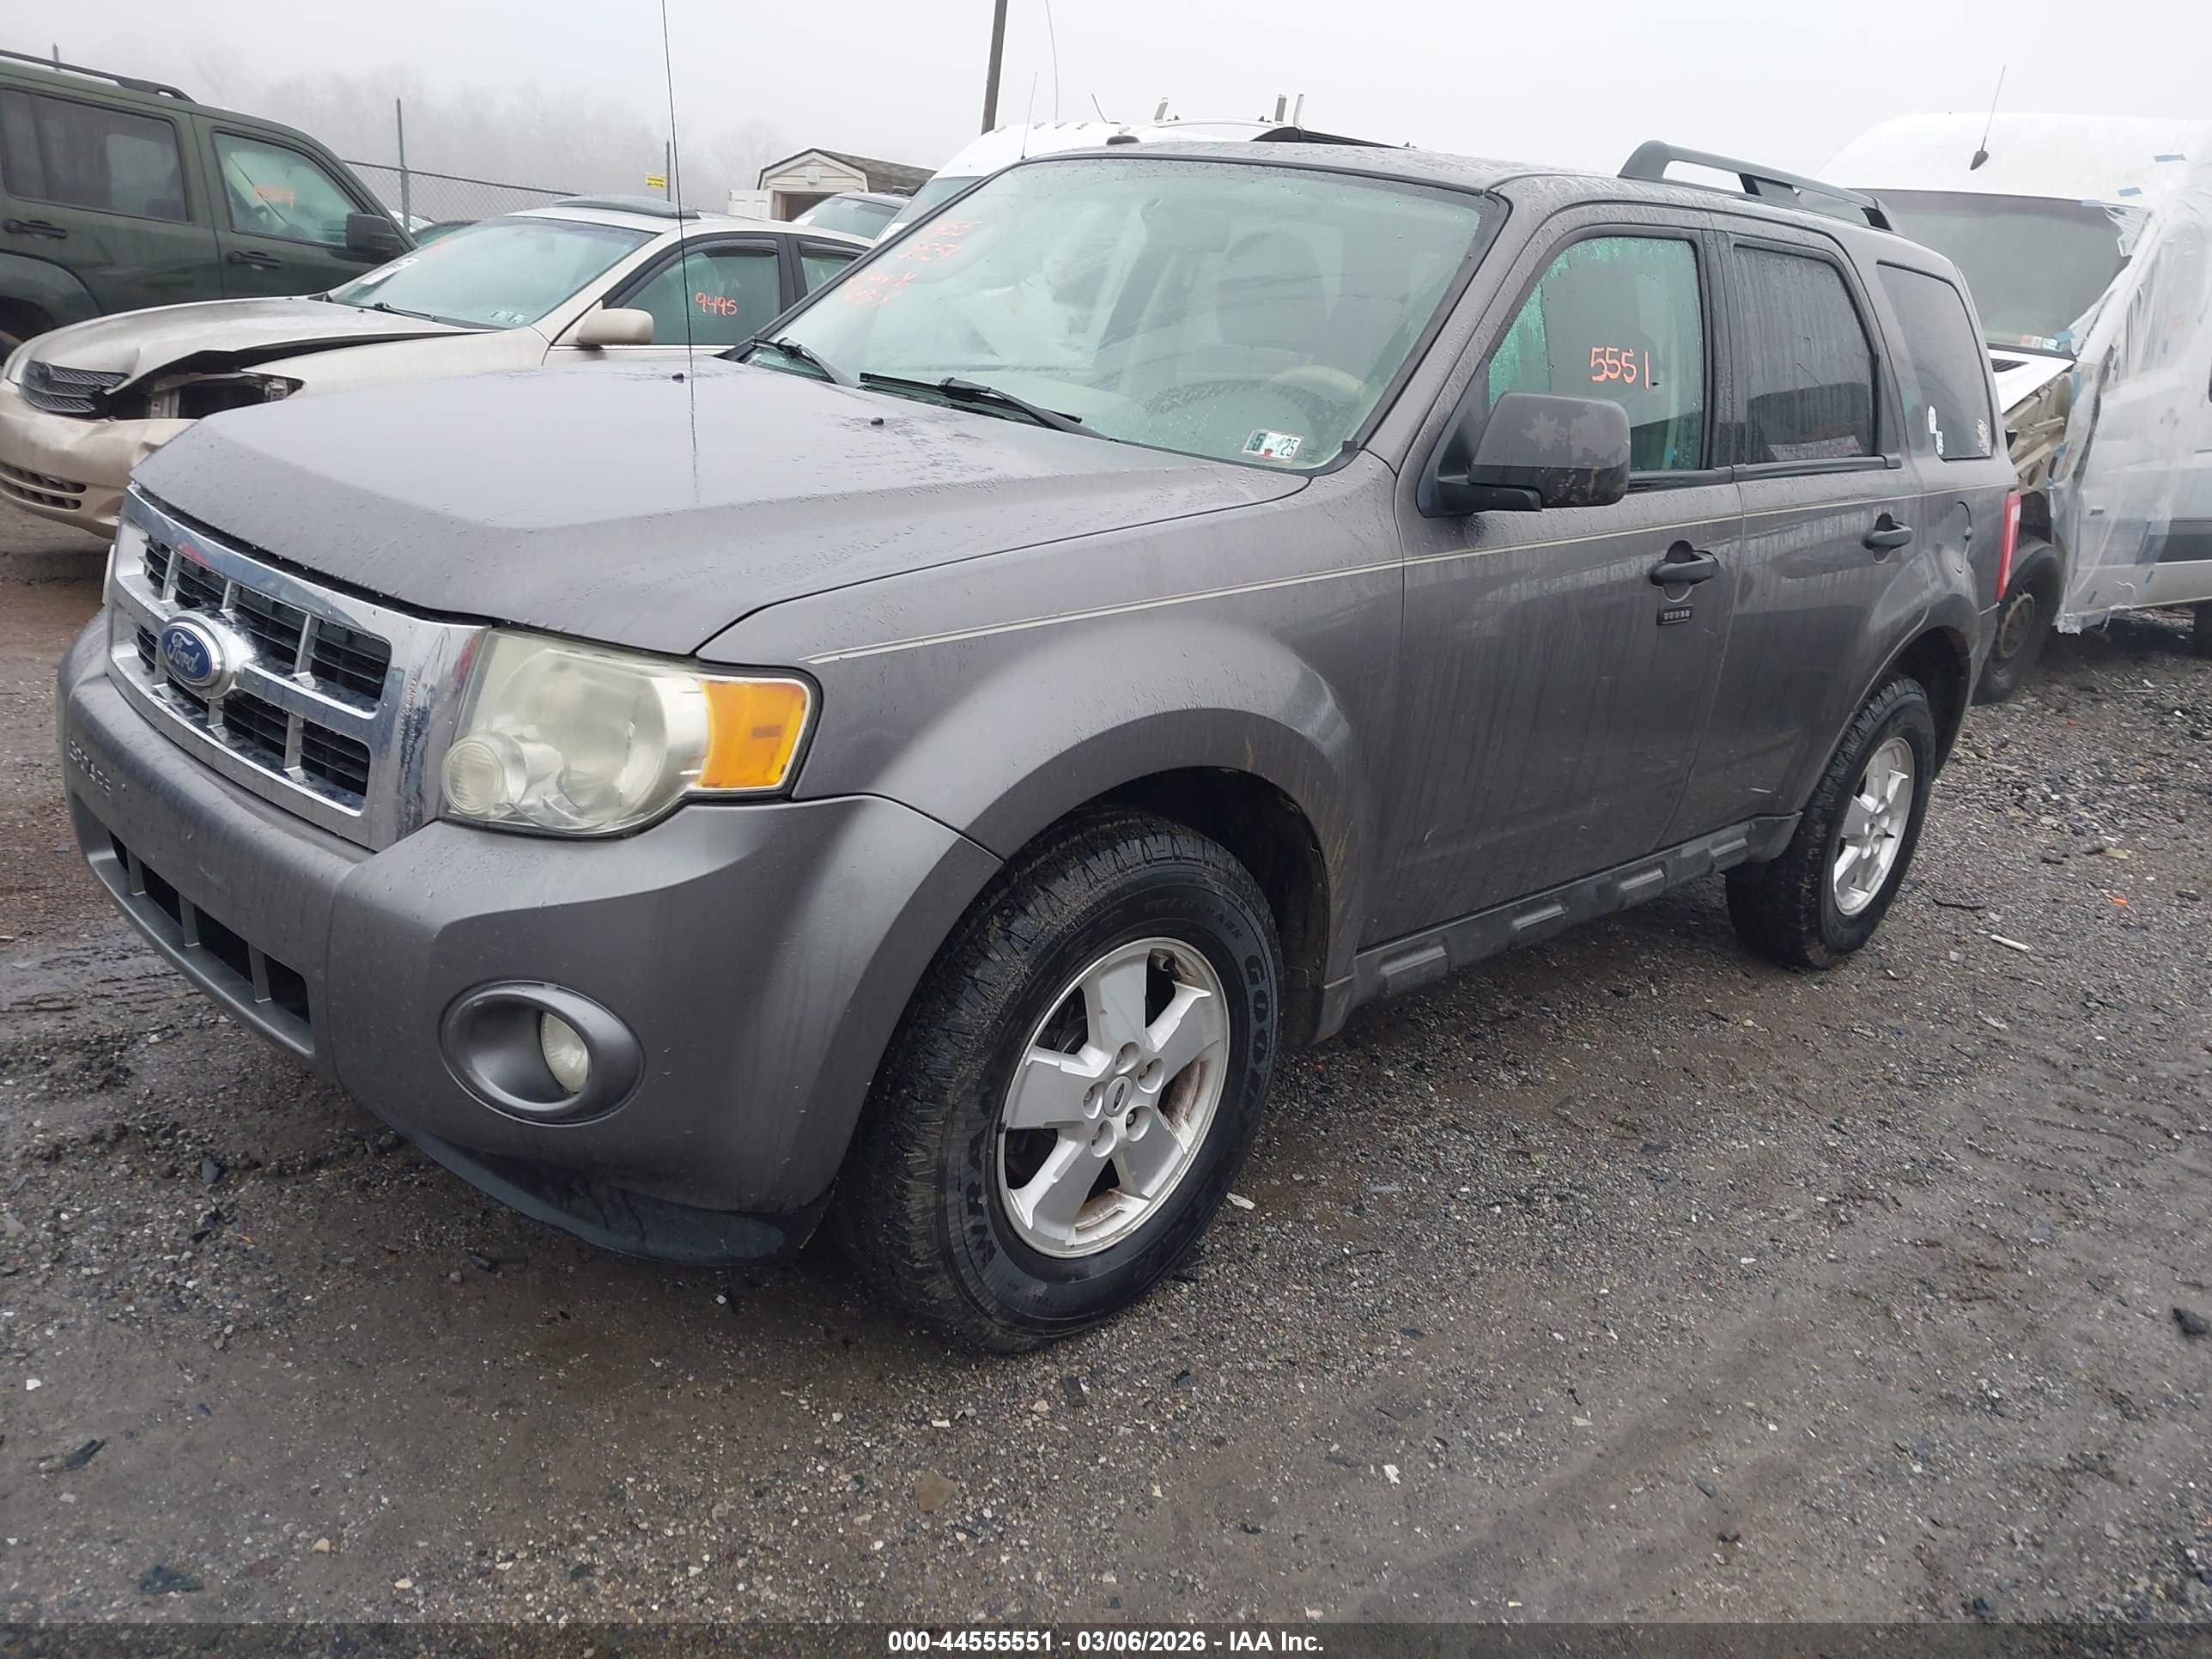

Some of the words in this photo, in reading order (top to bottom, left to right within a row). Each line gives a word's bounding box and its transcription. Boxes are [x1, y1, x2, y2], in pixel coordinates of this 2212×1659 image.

[695, 291, 738, 317] 9495
[1590, 346, 1650, 390] 5551
[1279, 438, 1299, 457] 25
[167, 631, 201, 674] Ford
